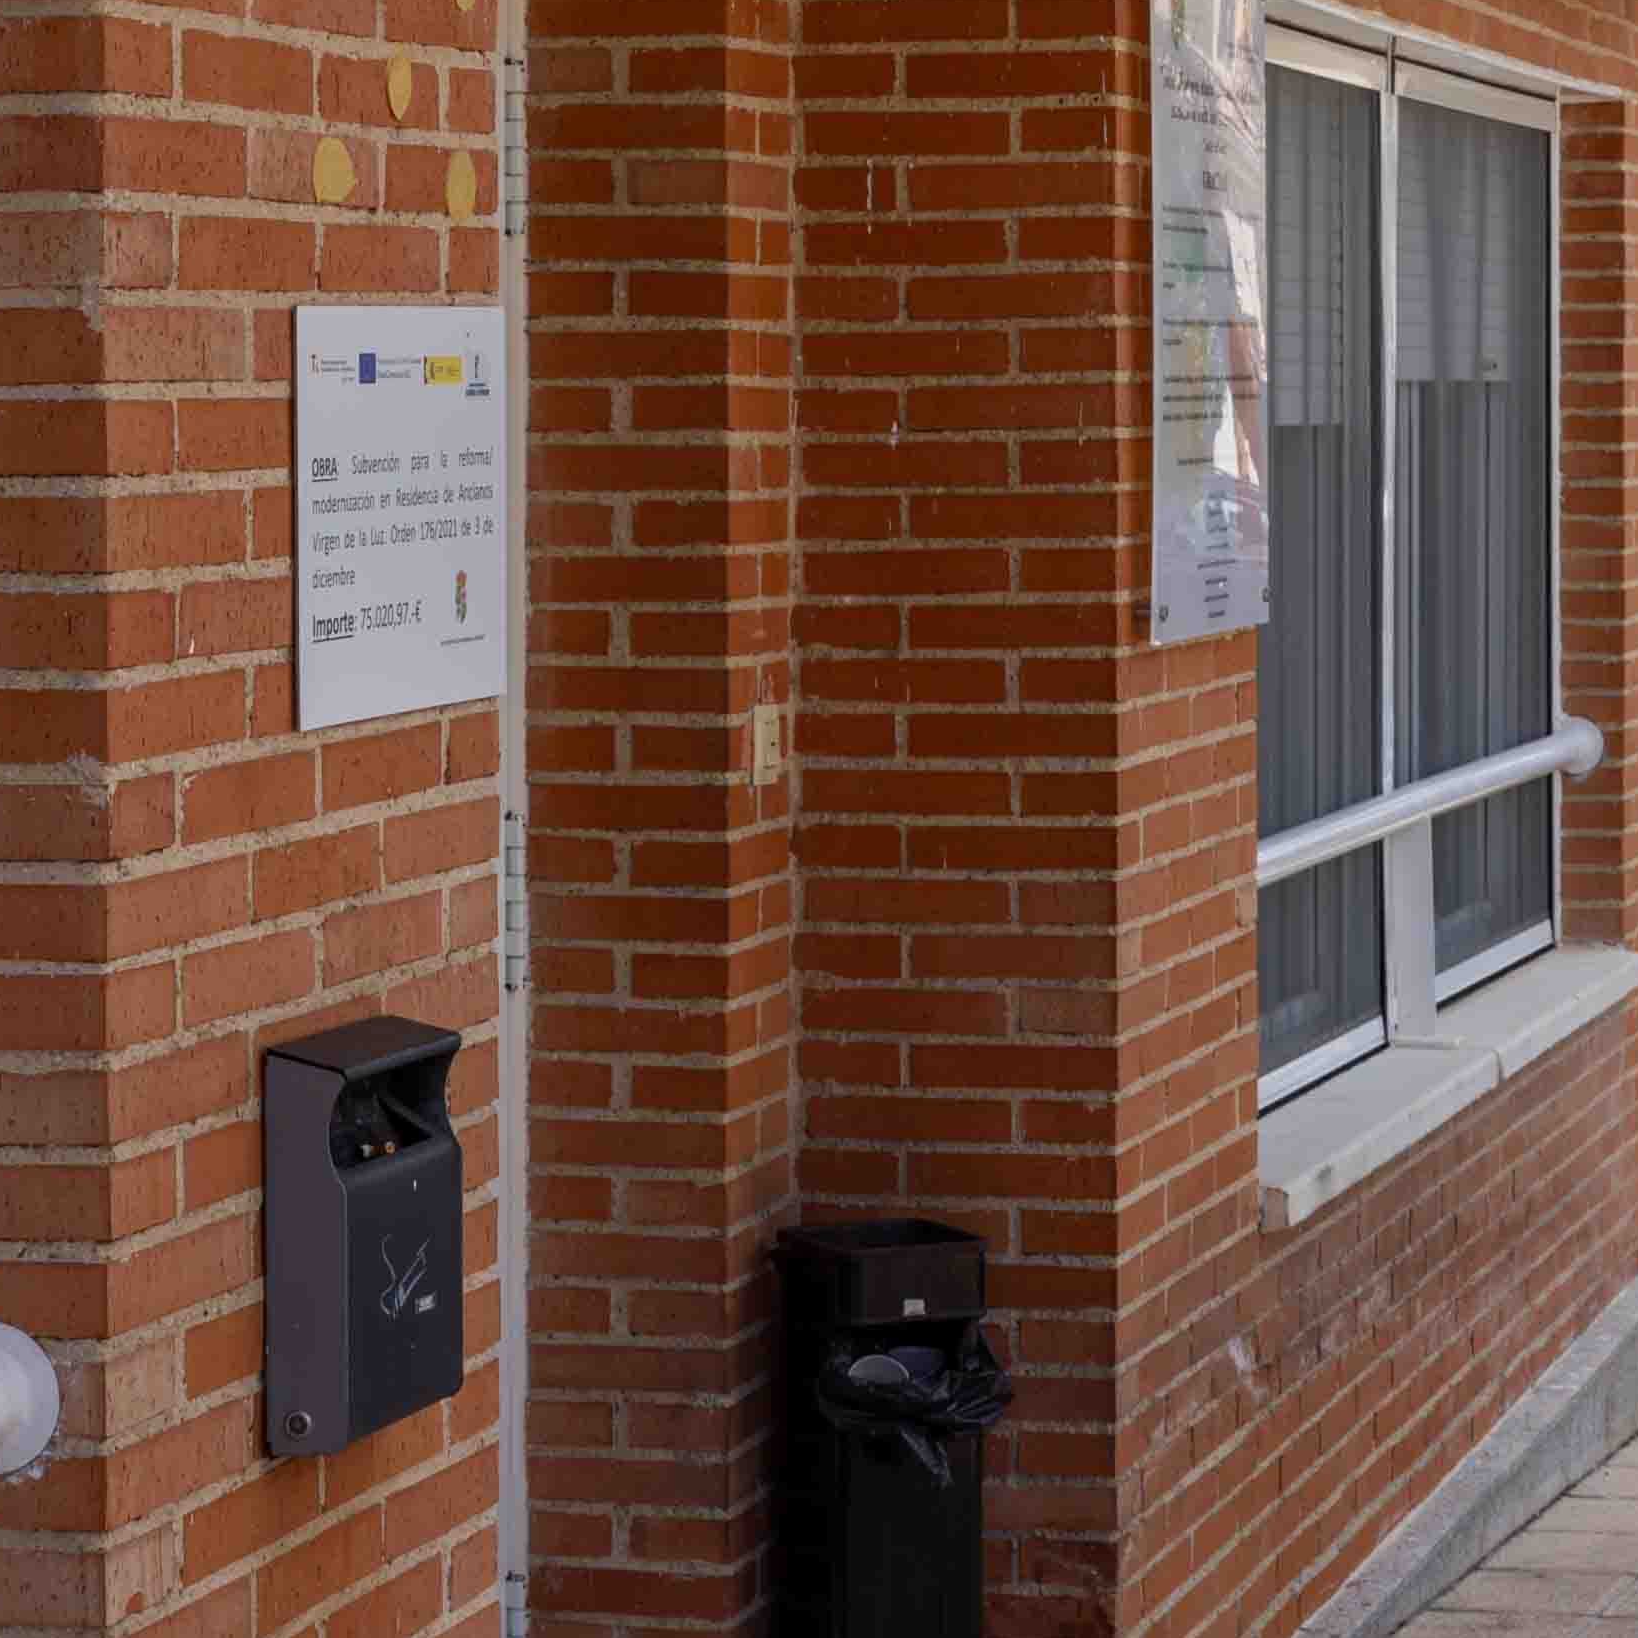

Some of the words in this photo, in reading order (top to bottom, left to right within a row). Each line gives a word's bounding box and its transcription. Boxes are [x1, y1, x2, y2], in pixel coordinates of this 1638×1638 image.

[351, 452, 400, 476] Subvención
[410, 454, 429, 473] para
[311, 489, 376, 515] modernización
[380, 493, 391, 509] en
[395, 486, 439, 508] Residencia
[442, 484, 455, 503] de
[458, 481, 494, 502] Ancianos
[311, 531, 341, 557] Virgen
[343, 529, 356, 549] de
[358, 529, 367, 548] la
[389, 521, 417, 544] Orden
[460, 519, 472, 537] de
[482, 514, 494, 534] de
[311, 564, 356, 589] diciembre
[311, 609, 358, 644] Importe:
